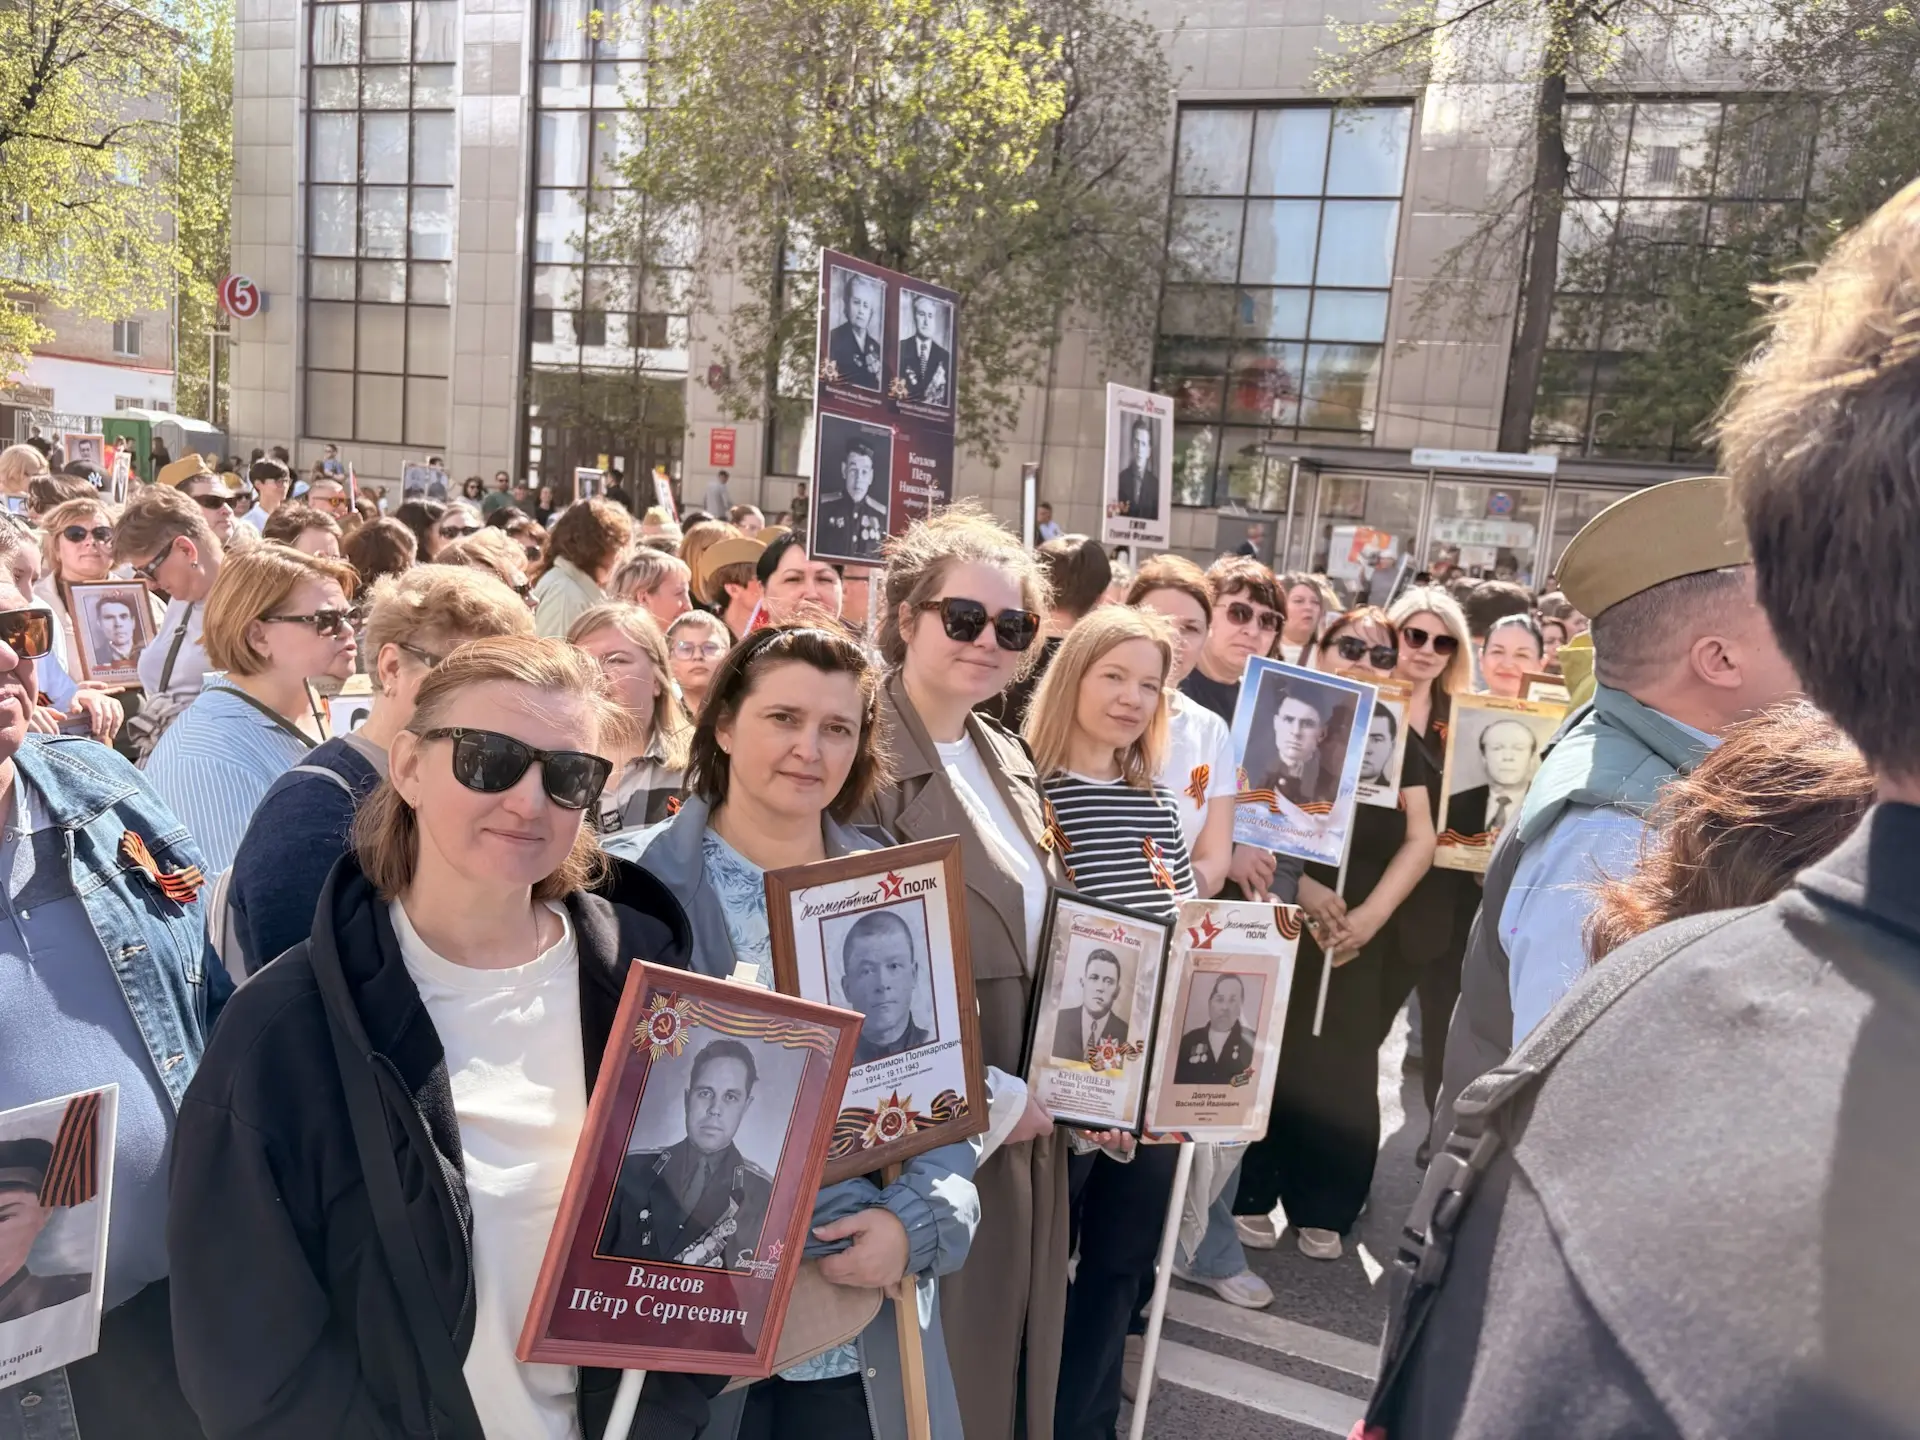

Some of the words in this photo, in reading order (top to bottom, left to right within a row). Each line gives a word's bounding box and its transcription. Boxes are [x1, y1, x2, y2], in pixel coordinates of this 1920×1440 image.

[904, 877, 937, 895] ПОЛК
[848, 1069, 864, 1079] нко
[865, 1056, 904, 1073] Филимон
[905, 1039, 961, 1062] Поликарпович
[865, 1074, 881, 1084] 1914
[887, 1062, 920, 1078] 19.11.1943
[1058, 1071, 1111, 1087] КРИВОШЕЕВ
[625, 1265, 705, 1294] Власов
[568, 1287, 629, 1320] Пётр
[634, 1294, 749, 1326] Сергеевич
[0, 1344, 42, 1366] горий
